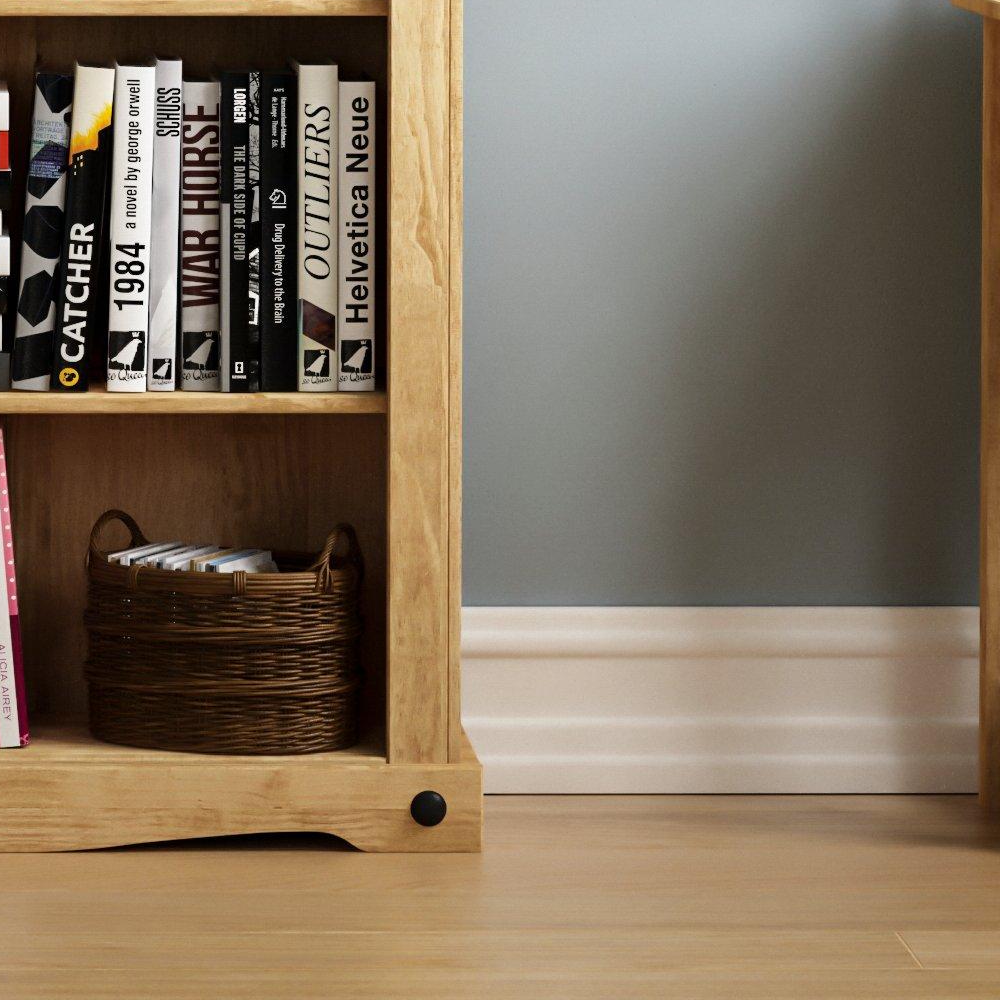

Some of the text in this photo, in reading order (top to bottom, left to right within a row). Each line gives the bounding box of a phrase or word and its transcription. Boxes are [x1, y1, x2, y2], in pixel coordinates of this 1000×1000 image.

[127, 79, 141, 117] orwell
[156, 87, 181, 137] SCHUSS
[233, 88, 246, 123] LORGEN
[127, 120, 141, 163] george
[124, 167, 140, 181] by
[304, 103, 331, 280] OUTLIERS
[123, 185, 137, 218] novel
[182, 102, 220, 308] WAR HORSE
[233, 145, 245, 261] THE DARK SIDE OF CUPID
[345, 96, 369, 324] Helvetica Neue
[273, 223, 284, 243] Drug
[114, 243, 145, 311] 1984
[273, 245, 285, 276] Delivery
[60, 223, 94, 363] CATCHER
[274, 288, 283, 299] the
[274, 302, 283, 324] Brain
[1, 686, 11, 722] AIREY
